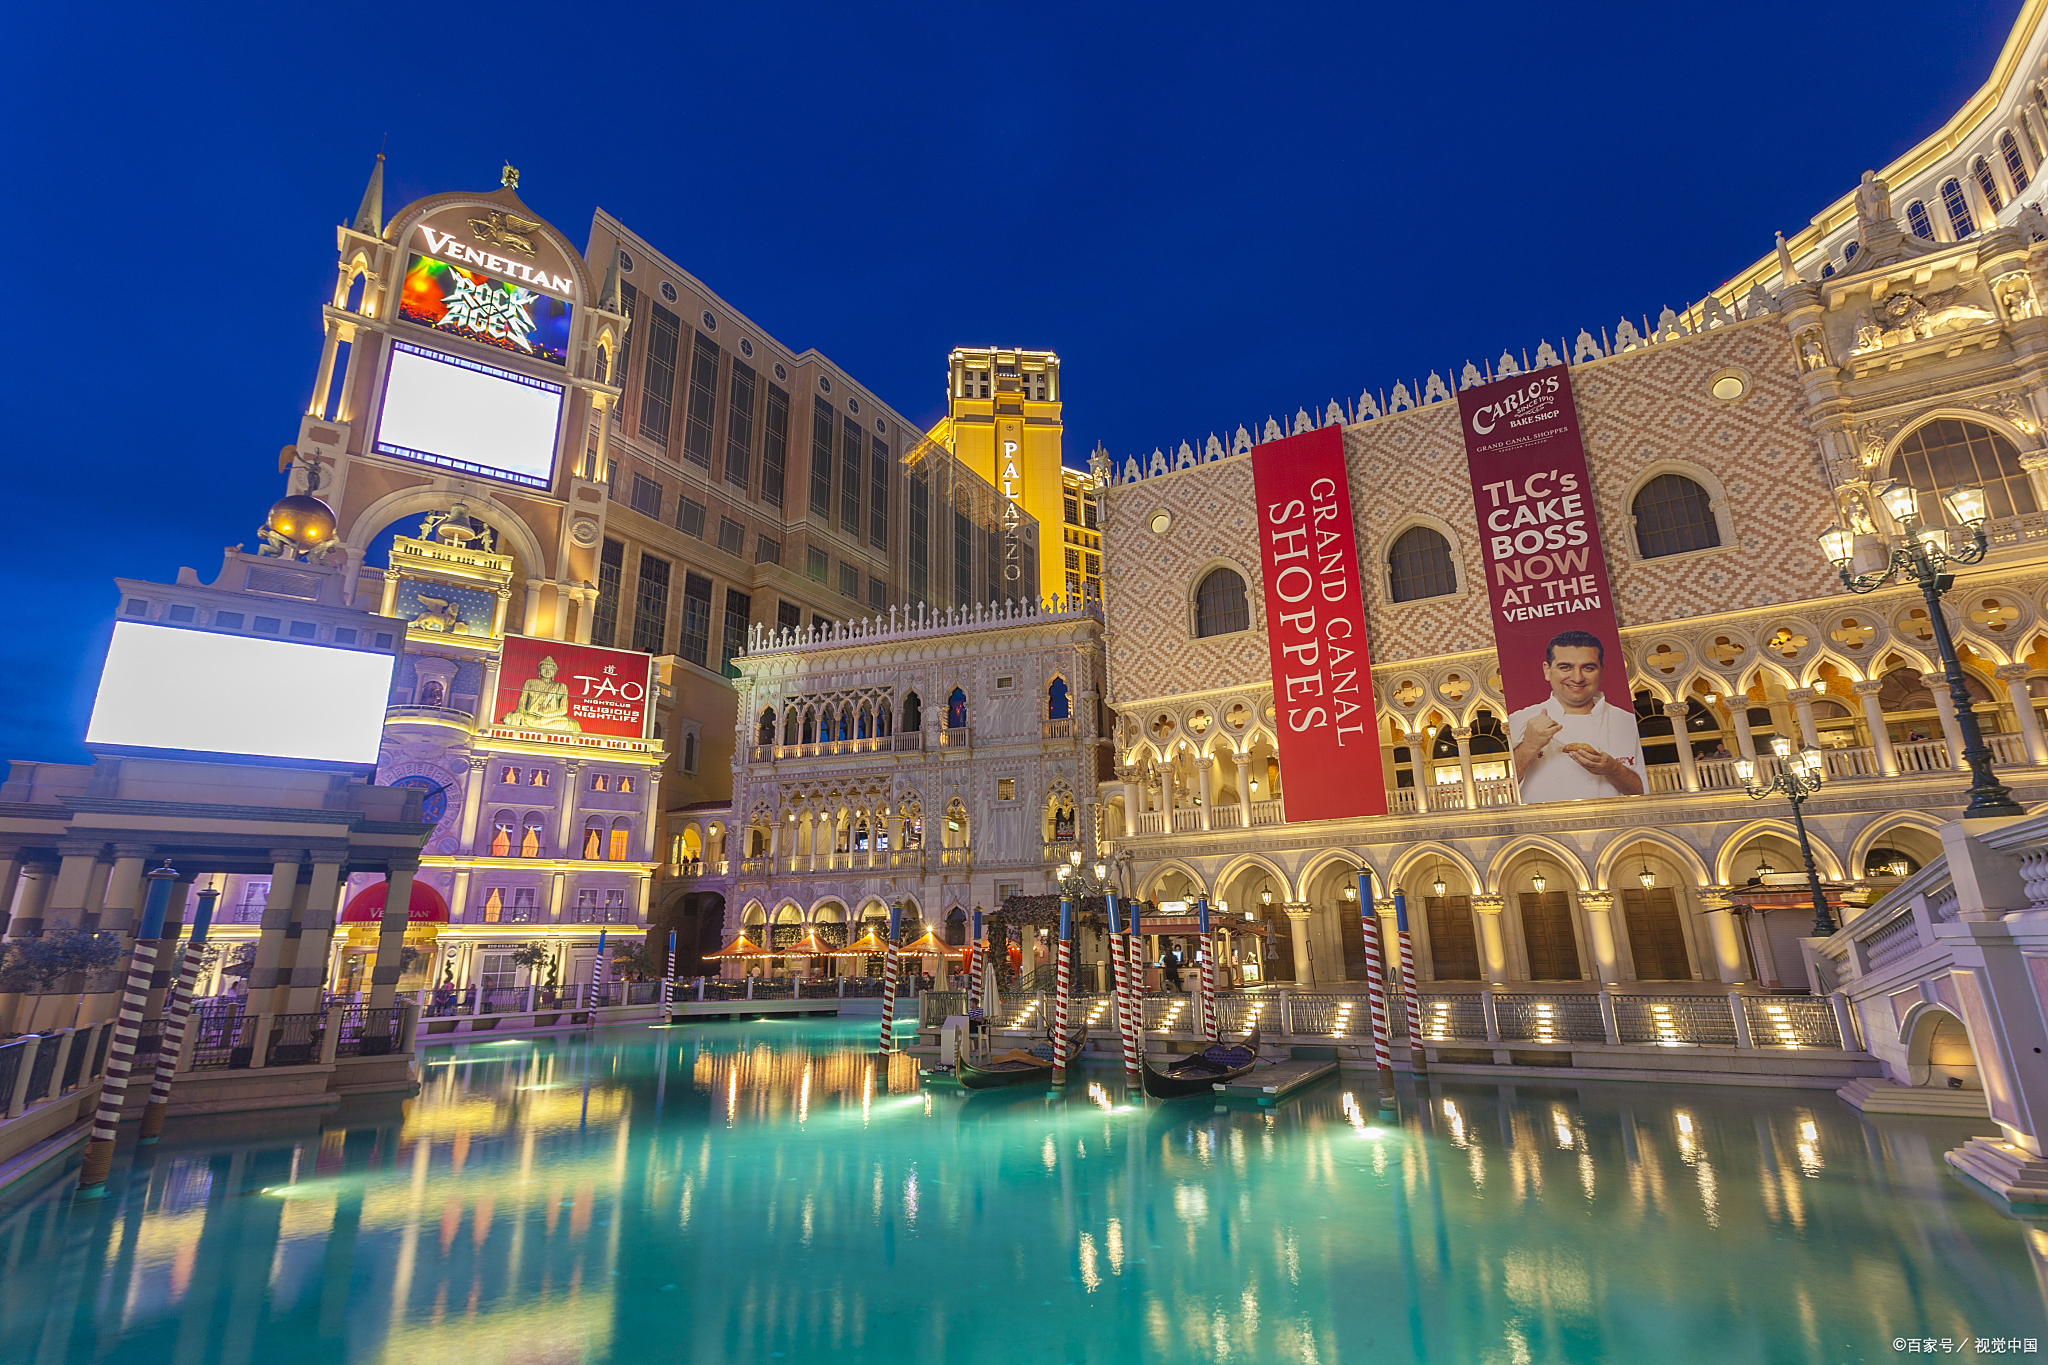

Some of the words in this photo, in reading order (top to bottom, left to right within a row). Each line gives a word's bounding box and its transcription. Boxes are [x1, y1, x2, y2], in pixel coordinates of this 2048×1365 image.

[418, 224, 573, 295] VENETIAN
[441, 266, 540, 331] ROCK
[436, 300, 534, 353] AGES
[1472, 375, 1560, 435] CARLO'S
[1509, 415, 1534, 429] BAKE
[1534, 409, 1560, 422] SHOP
[1516, 399, 1538, 414] SINCE
[1476, 441, 1504, 453] GRAND
[1505, 435, 1533, 446] CANAL
[1533, 426, 1569, 440] SHOPPES
[1482, 469, 1579, 507] TLC's
[1002, 441, 1021, 581] PALAZZO
[1487, 493, 1585, 532] CAKE
[1310, 477, 1347, 602] GRAND
[1491, 520, 1589, 560] BOSS
[1494, 546, 1590, 587] NOW
[1501, 584, 1534, 608] AT
[1540, 574, 1598, 600] THE
[1502, 595, 1601, 623] VENETIAN
[1268, 499, 1328, 732] SHOPPES
[573, 675, 644, 701] TAO
[602, 664, 619, 677] 道
[1325, 617, 1364, 747] CANAL
[573, 704, 640, 717] RELIGIOUS
[573, 710, 638, 723] NIGHTLIFE
[583, 698, 631, 709] NIGHTCLUB
[369, 907, 429, 919] VEIAN
